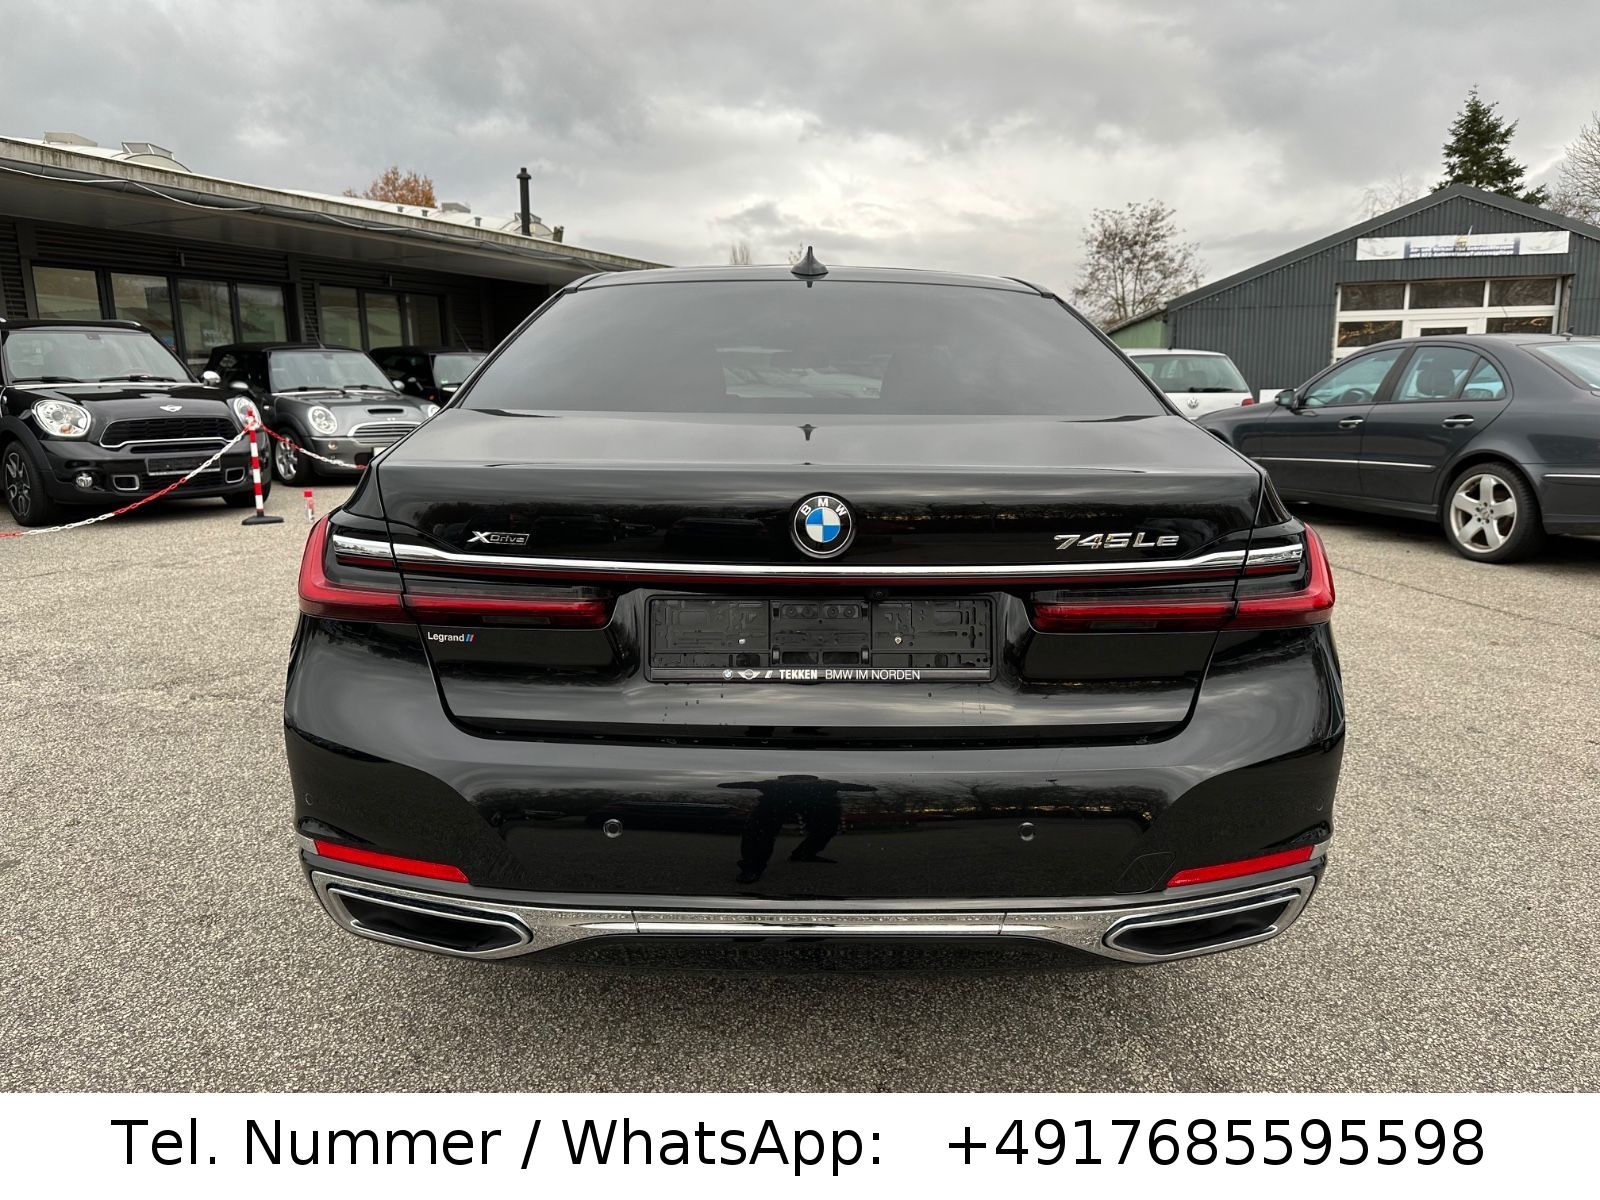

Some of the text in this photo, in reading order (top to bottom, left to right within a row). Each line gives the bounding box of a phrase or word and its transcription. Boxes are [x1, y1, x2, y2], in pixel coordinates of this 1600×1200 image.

[800, 497, 847, 516] BMW
[1053, 532, 1180, 550] 745Le
[427, 631, 465, 643] Legrand
[779, 669, 921, 680] TEKKEN BMW IM NORDEN
